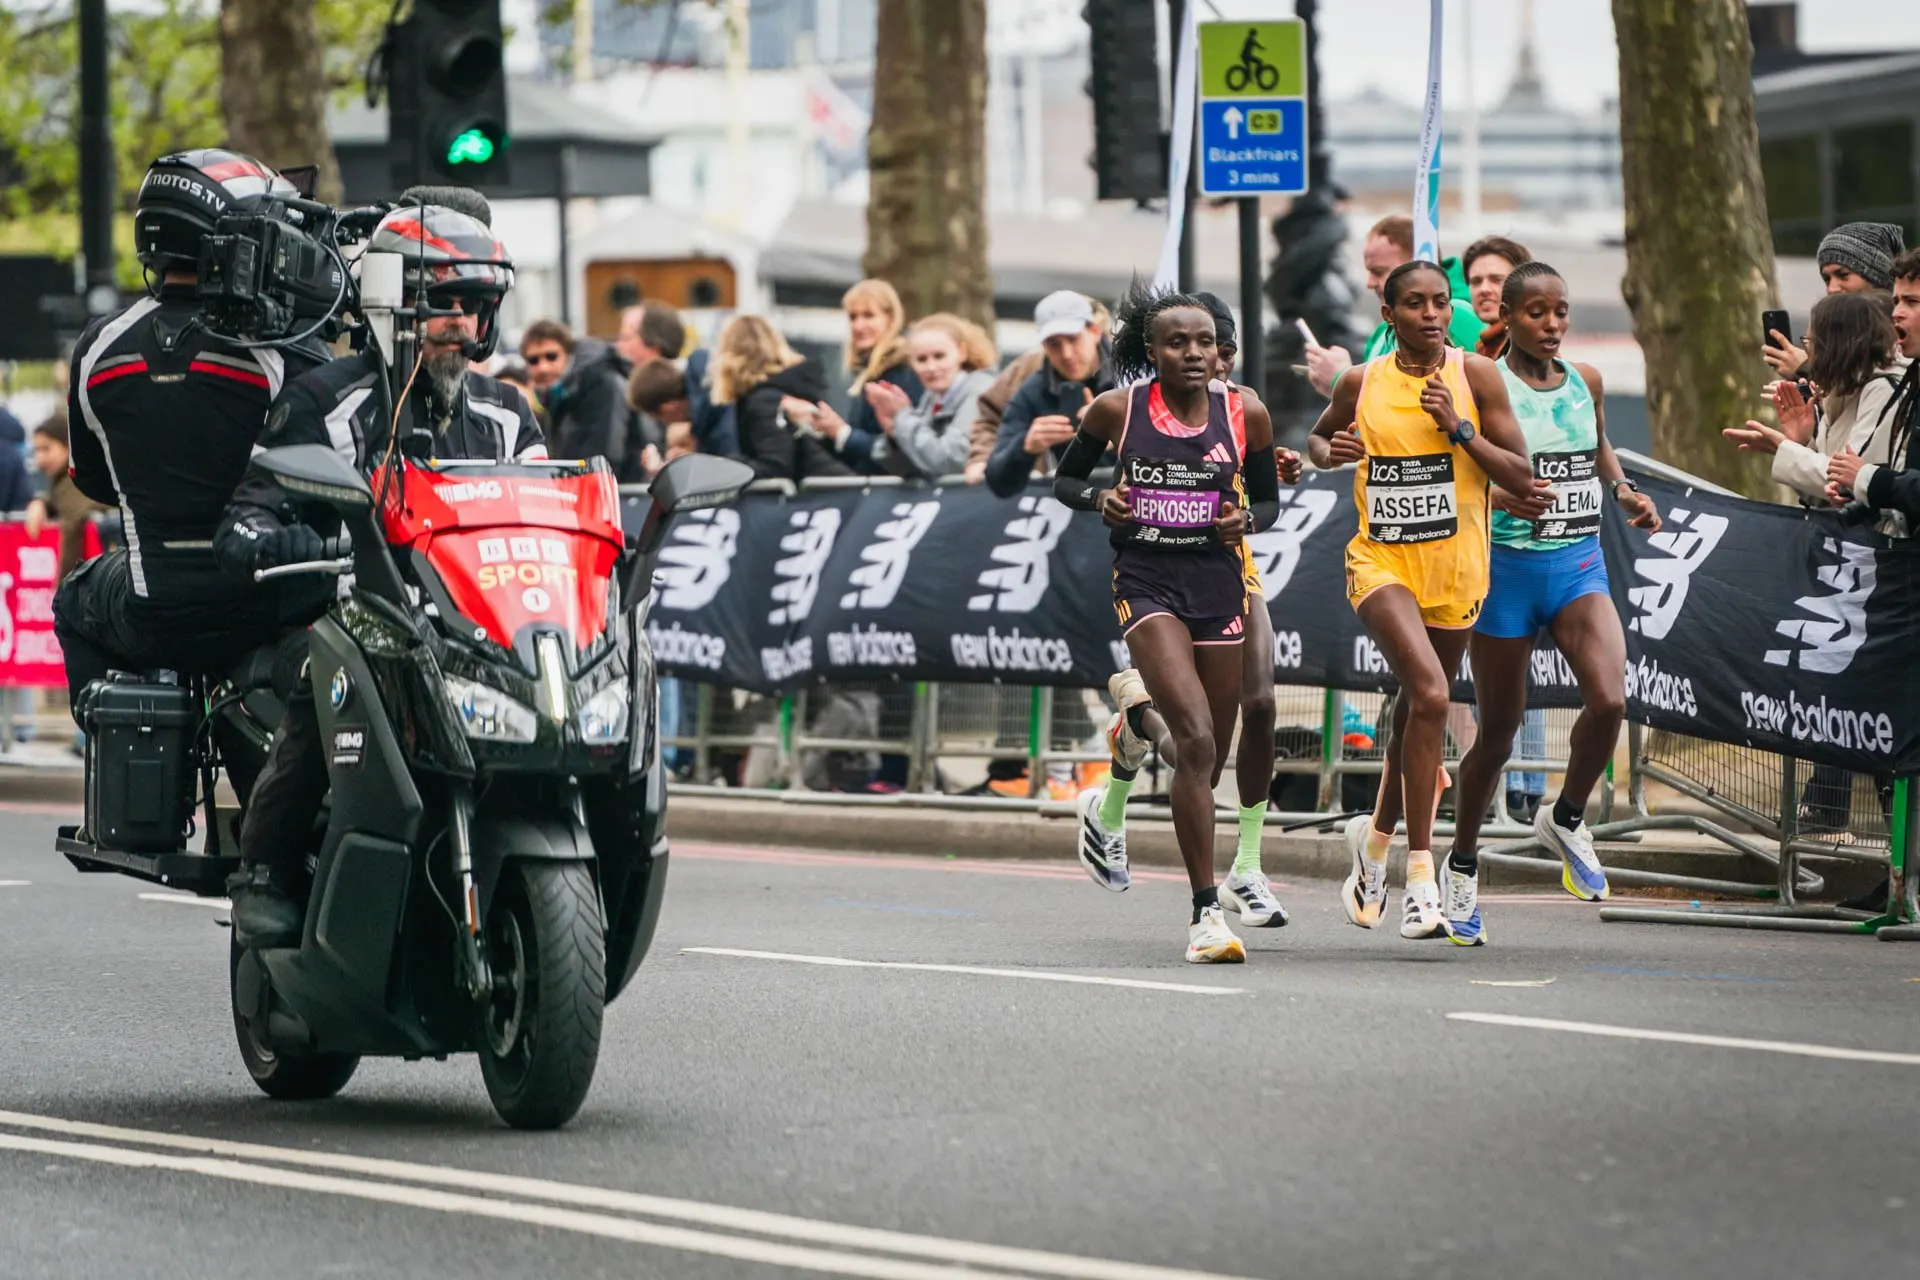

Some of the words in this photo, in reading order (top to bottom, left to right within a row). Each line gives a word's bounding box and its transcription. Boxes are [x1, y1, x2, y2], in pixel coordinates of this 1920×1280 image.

[1209, 146, 1299, 162] Blackfriars
[1228, 169, 1239, 185] 3
[1242, 171, 1279, 184] mins
[1132, 461, 1163, 484] tcs
[1166, 471, 1214, 480] CONSULTANCY
[1371, 459, 1399, 481] tcs
[1401, 464, 1448, 475] CONSULTANCY
[1402, 473, 1432, 482] SERVICES
[1538, 457, 1569, 479] tcs
[1133, 497, 1213, 523] JEPKOSGEI
[1373, 494, 1451, 519] ASSEFA
[1160, 537, 1176, 545] new
[1176, 535, 1209, 545] balance
[1419, 529, 1451, 540] balance
[477, 562, 577, 590] SPORT
[951, 632, 989, 669] new
[987, 625, 1074, 673] balance
[1637, 654, 1698, 718] balance
[1740, 691, 1787, 735] new
[1789, 690, 1894, 754] balance
